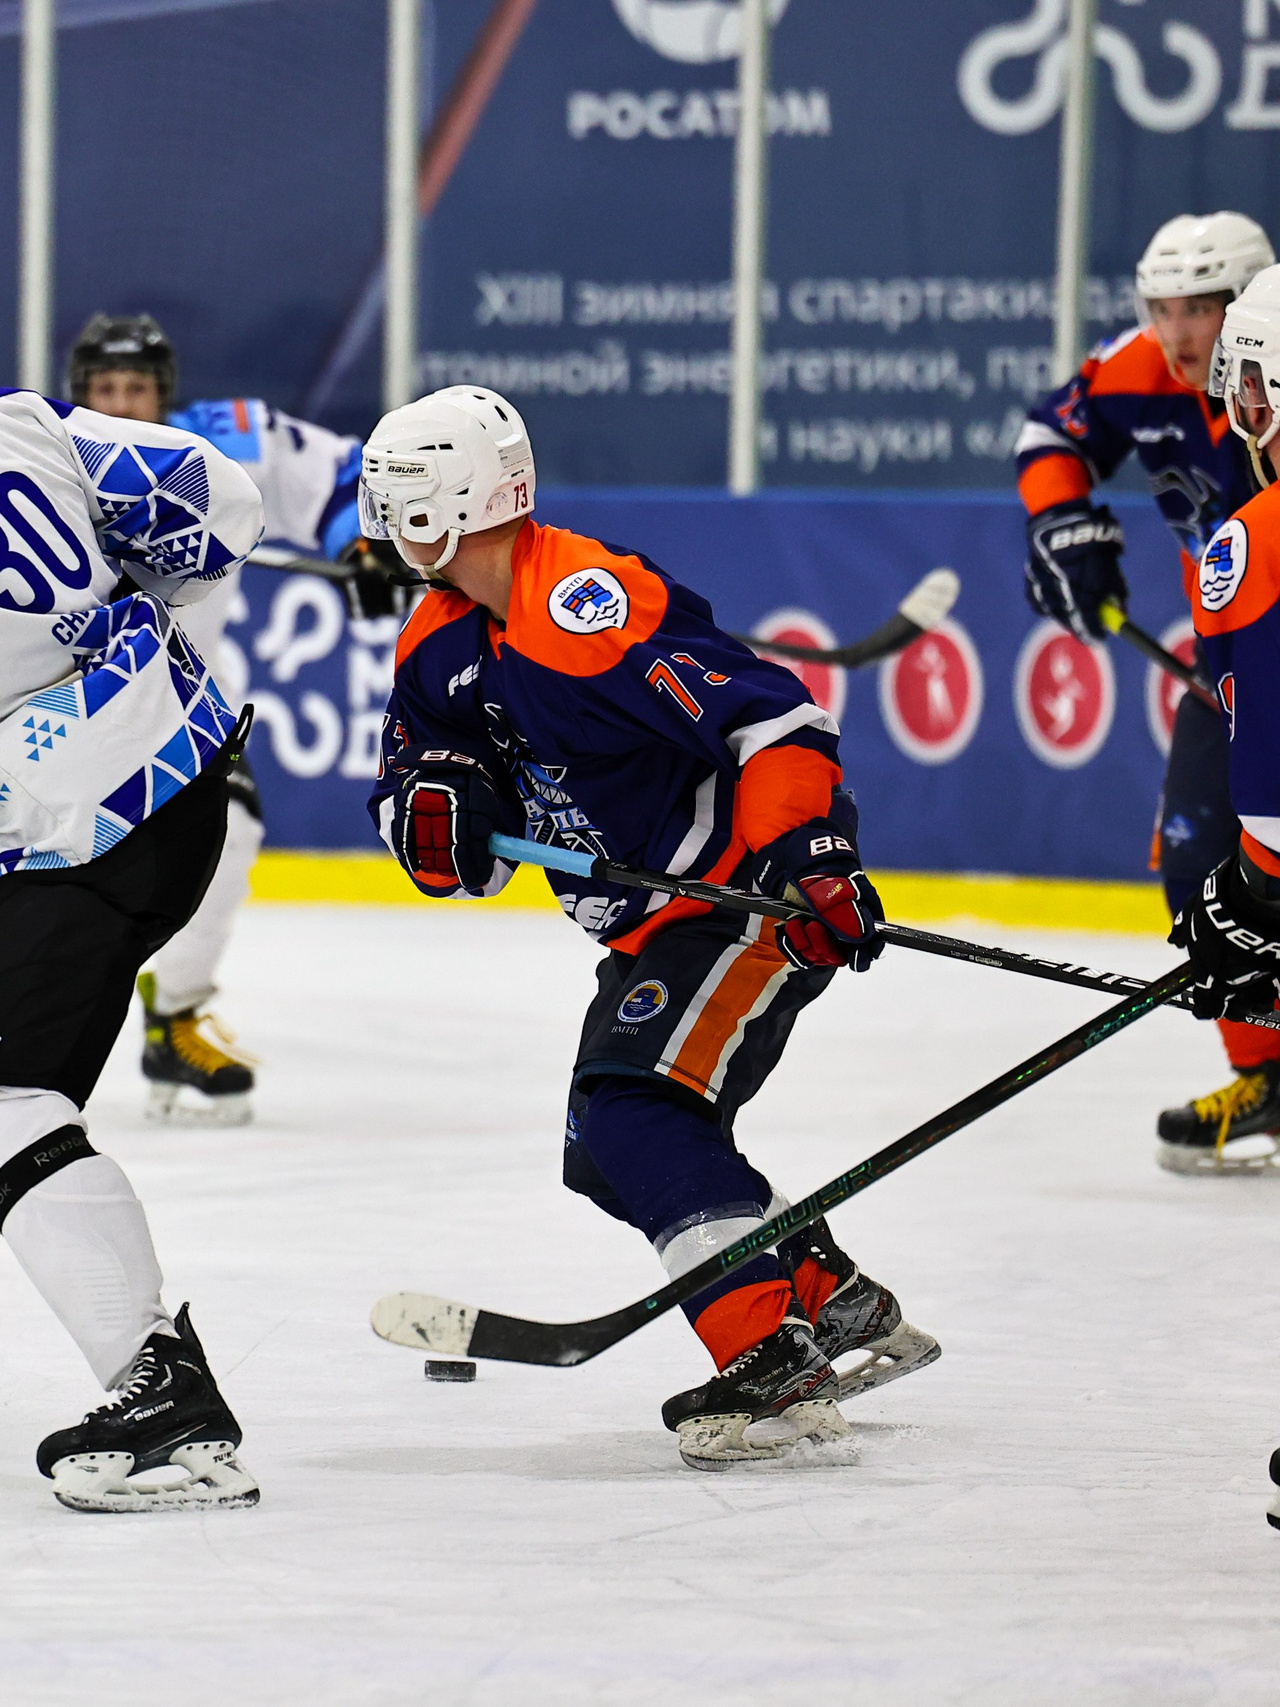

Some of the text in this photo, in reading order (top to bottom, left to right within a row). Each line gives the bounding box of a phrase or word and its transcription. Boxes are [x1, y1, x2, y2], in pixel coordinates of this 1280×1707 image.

[788, 277, 1138, 332] спартакида
[1235, 335, 1265, 348] CCM
[387, 464, 426, 475] BAUER
[513, 482, 529, 513] 73
[720, 1159, 873, 1275] BAUER
[133, 1400, 176, 1422] BAUER
